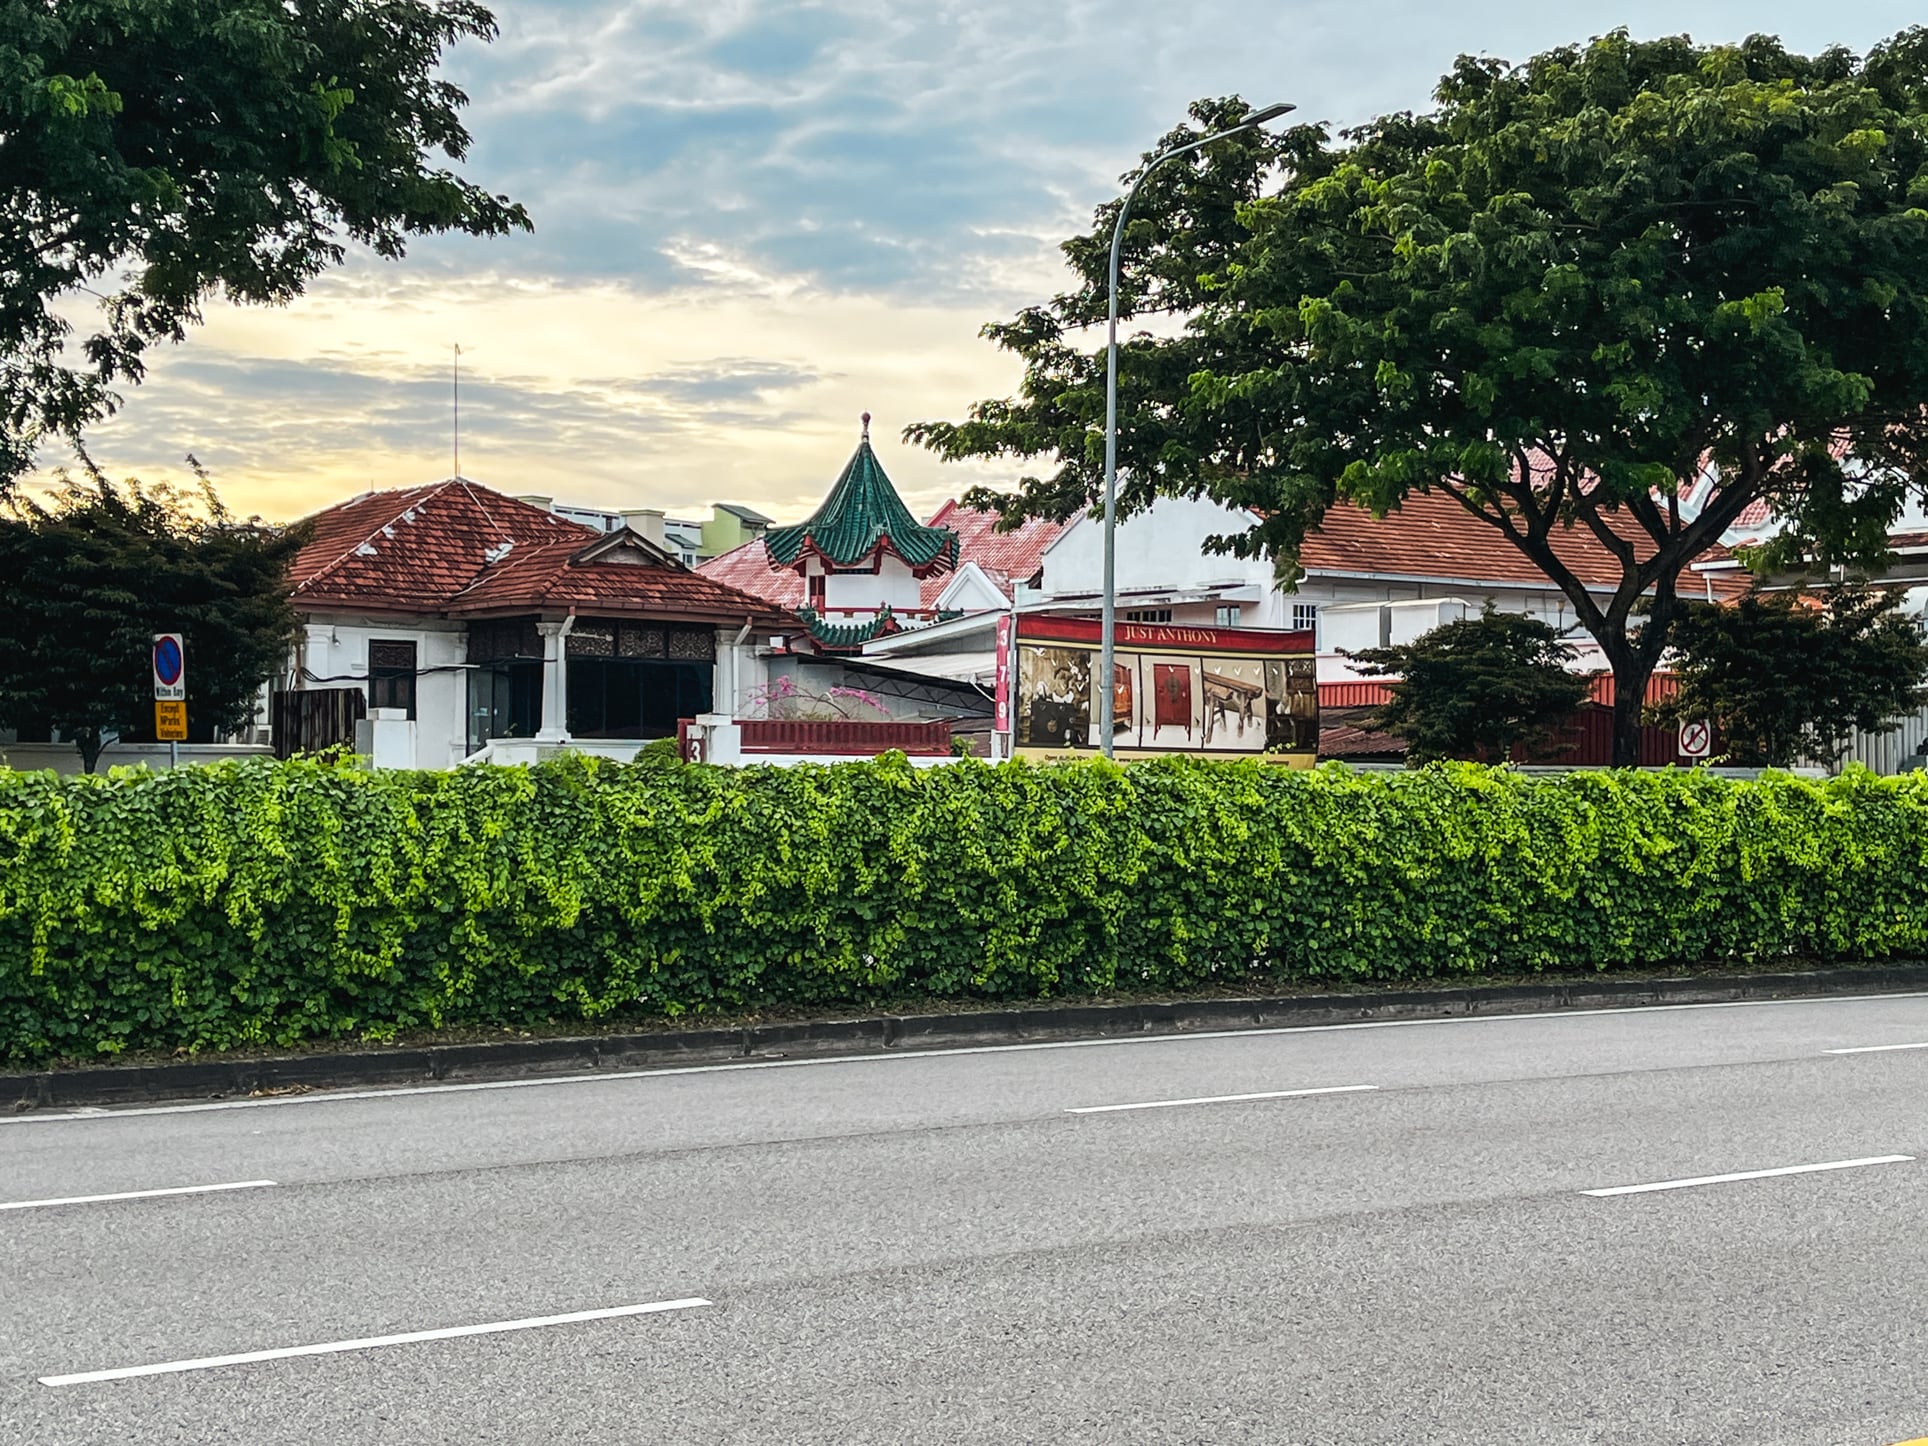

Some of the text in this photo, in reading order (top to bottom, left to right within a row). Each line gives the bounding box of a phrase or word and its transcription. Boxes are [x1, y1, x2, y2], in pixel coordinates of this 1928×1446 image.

[1125, 625, 1217, 643] JUST ANTHONY
[173, 686, 183, 699] Bay
